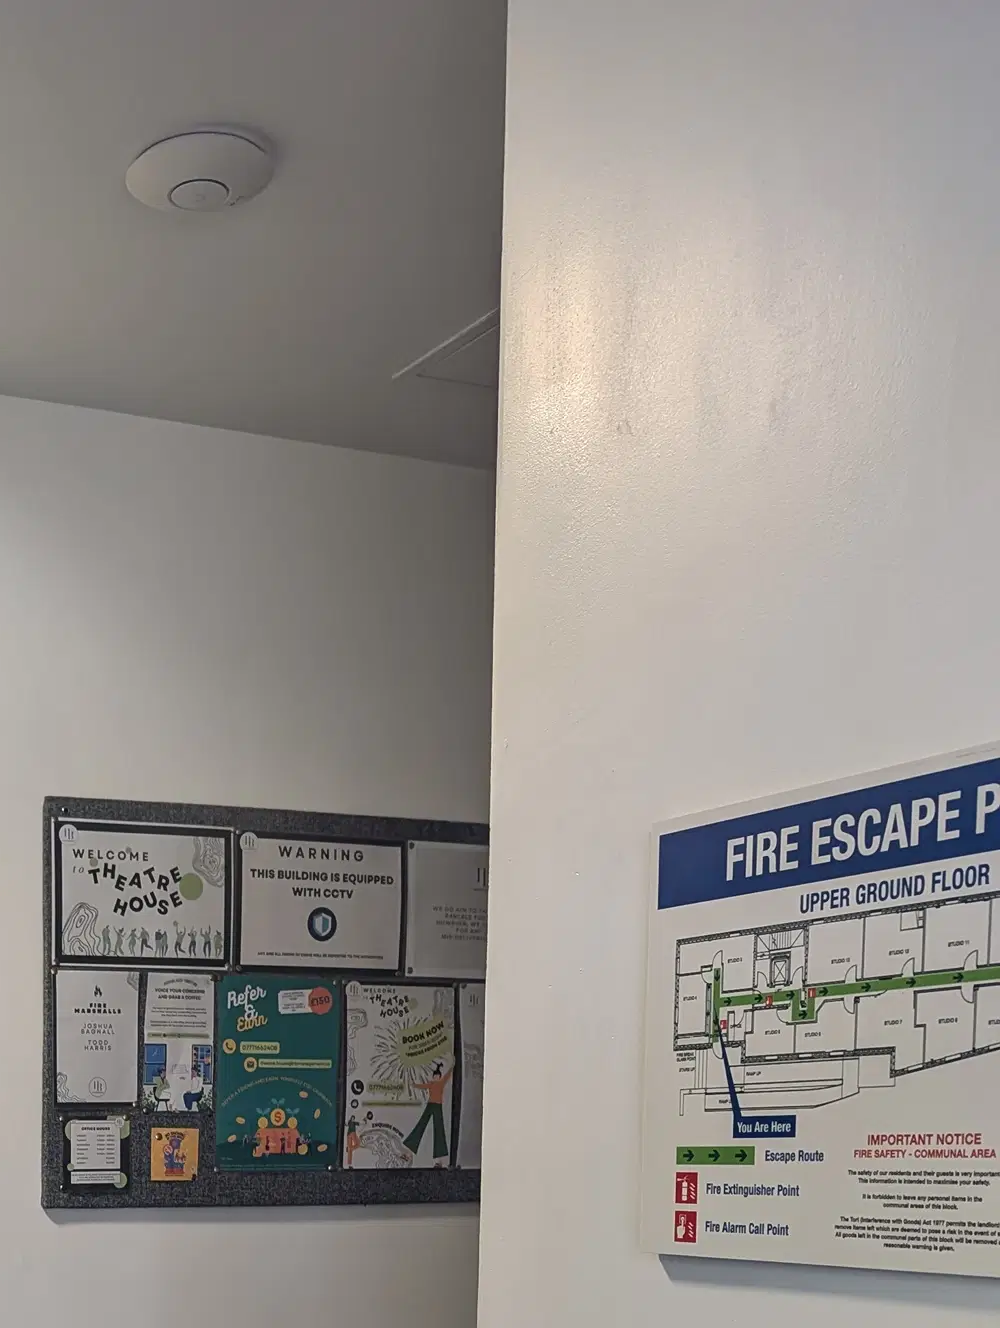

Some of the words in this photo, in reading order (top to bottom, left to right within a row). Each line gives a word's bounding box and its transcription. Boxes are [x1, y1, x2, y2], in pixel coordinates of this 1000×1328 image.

[726, 825, 799, 881] FIRE
[811, 790, 962, 865] ESCAPE
[72, 848, 149, 862] WELCOME
[278, 845, 364, 862] WARNING
[88, 863, 182, 891] THEATRE
[250, 868, 275, 879] THIS
[278, 870, 328, 882] BUILDING
[331, 873, 340, 882] IS
[343, 873, 394, 885] EQUIPPED
[292, 887, 321, 898] WITH
[323, 888, 354, 899] CCTV
[800, 888, 849, 914] UPPER
[856, 874, 925, 905] GROUND
[932, 864, 990, 893] FLOOR
[113, 891, 183, 916] HOUSE
[227, 985, 267, 1009] Refer
[369, 994, 409, 1007] THEATRE
[380, 1006, 409, 1018] HOUSE
[236, 1015, 268, 1032] Earn
[402, 1032, 425, 1044] BOOK
[426, 1020, 444, 1037] NOW
[737, 1122, 751, 1133] You
[754, 1122, 769, 1133] Are
[771, 1121, 791, 1132] Here
[867, 1133, 933, 1145] IMPORTANT
[936, 1133, 982, 1145] NOTICE
[765, 1150, 796, 1164] Escape
[798, 1150, 824, 1162] Route
[853, 1149, 872, 1158] FIRE
[874, 1149, 906, 1158] SAFETY
[914, 1149, 968, 1159] COMMUNAL
[970, 1149, 996, 1158] AREA
[706, 1183, 722, 1195] Fire
[723, 1183, 775, 1198] Extinguisher
[777, 1184, 800, 1197] Point
[705, 1221, 720, 1232] Fire
[722, 1221, 747, 1234] Alarm
[748, 1222, 765, 1235] Call
[767, 1223, 789, 1236] Point
